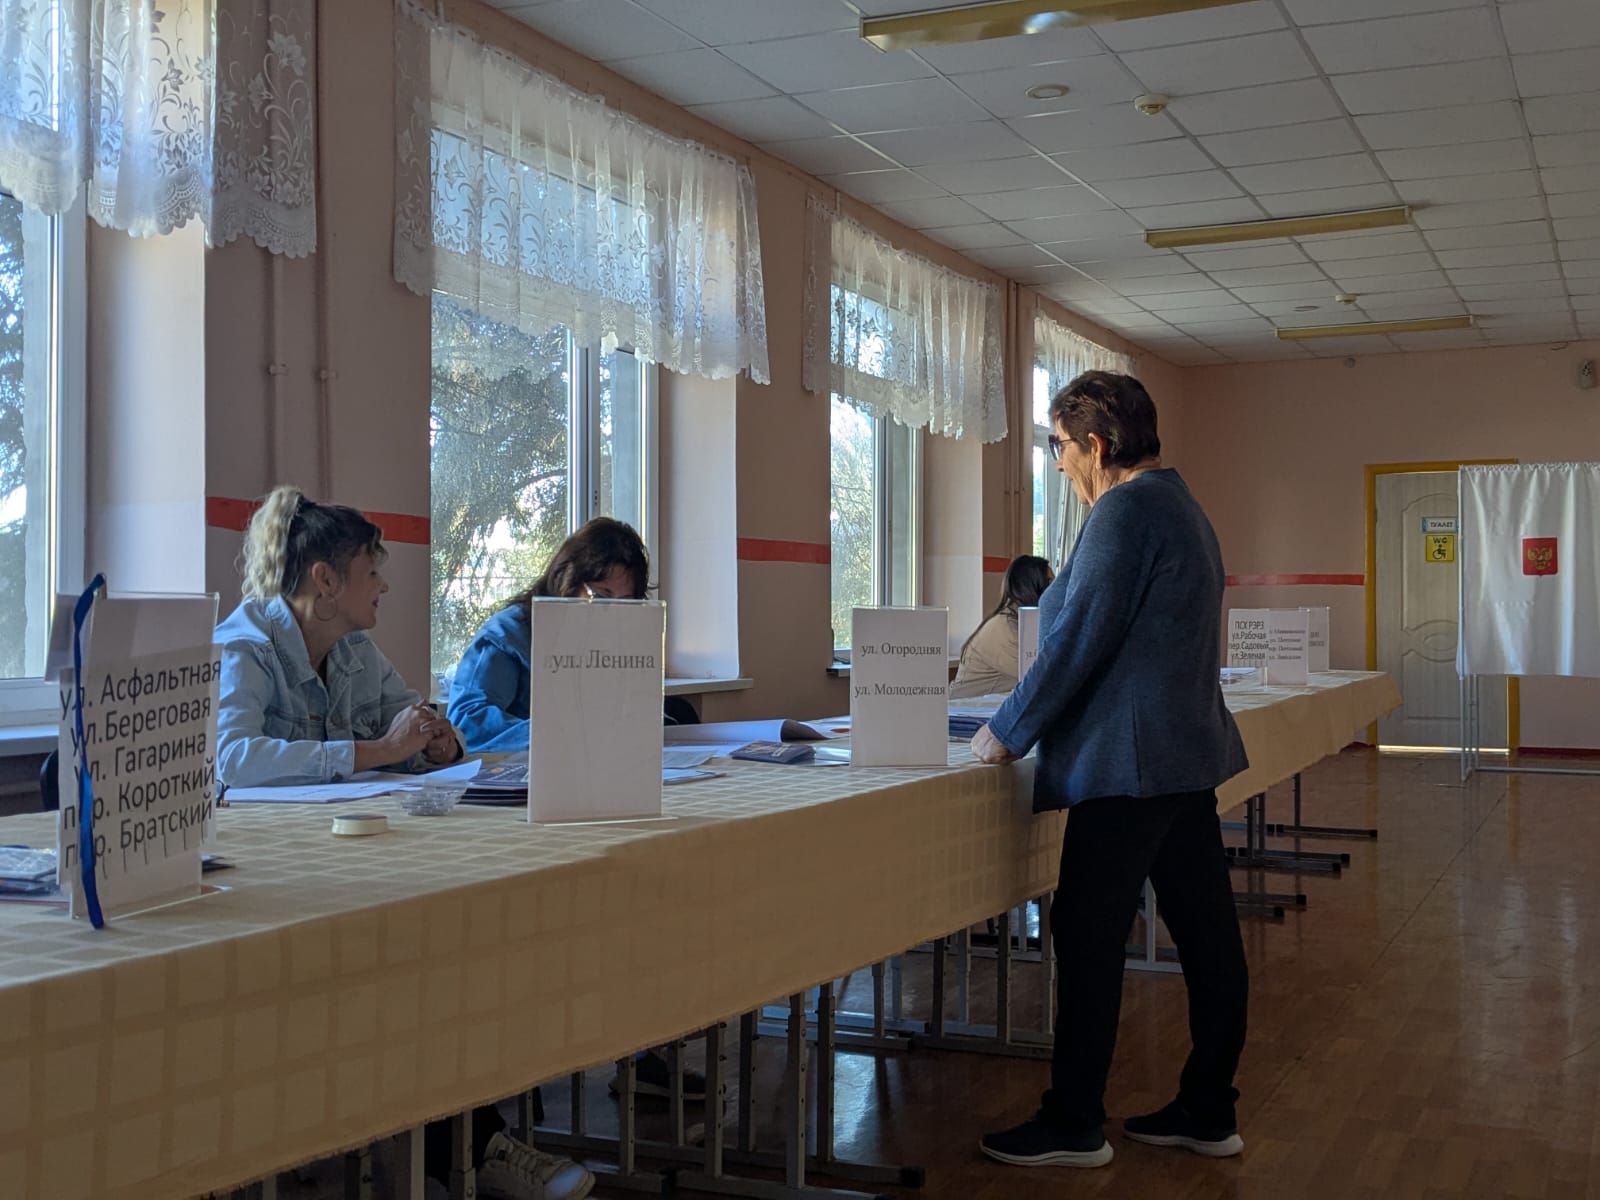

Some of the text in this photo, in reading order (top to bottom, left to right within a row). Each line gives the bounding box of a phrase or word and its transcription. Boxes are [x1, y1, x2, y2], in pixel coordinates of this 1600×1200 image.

[552, 649, 655, 673] ул. Ленина
[861, 645, 878, 656] ул.
[100, 660, 221, 705] Асфальтная
[854, 683, 945, 698] ул. Молодежная
[115, 732, 207, 777] Гагарина
[64, 756, 215, 830] пр. Короткий
[65, 792, 212, 868] пр. Братский
